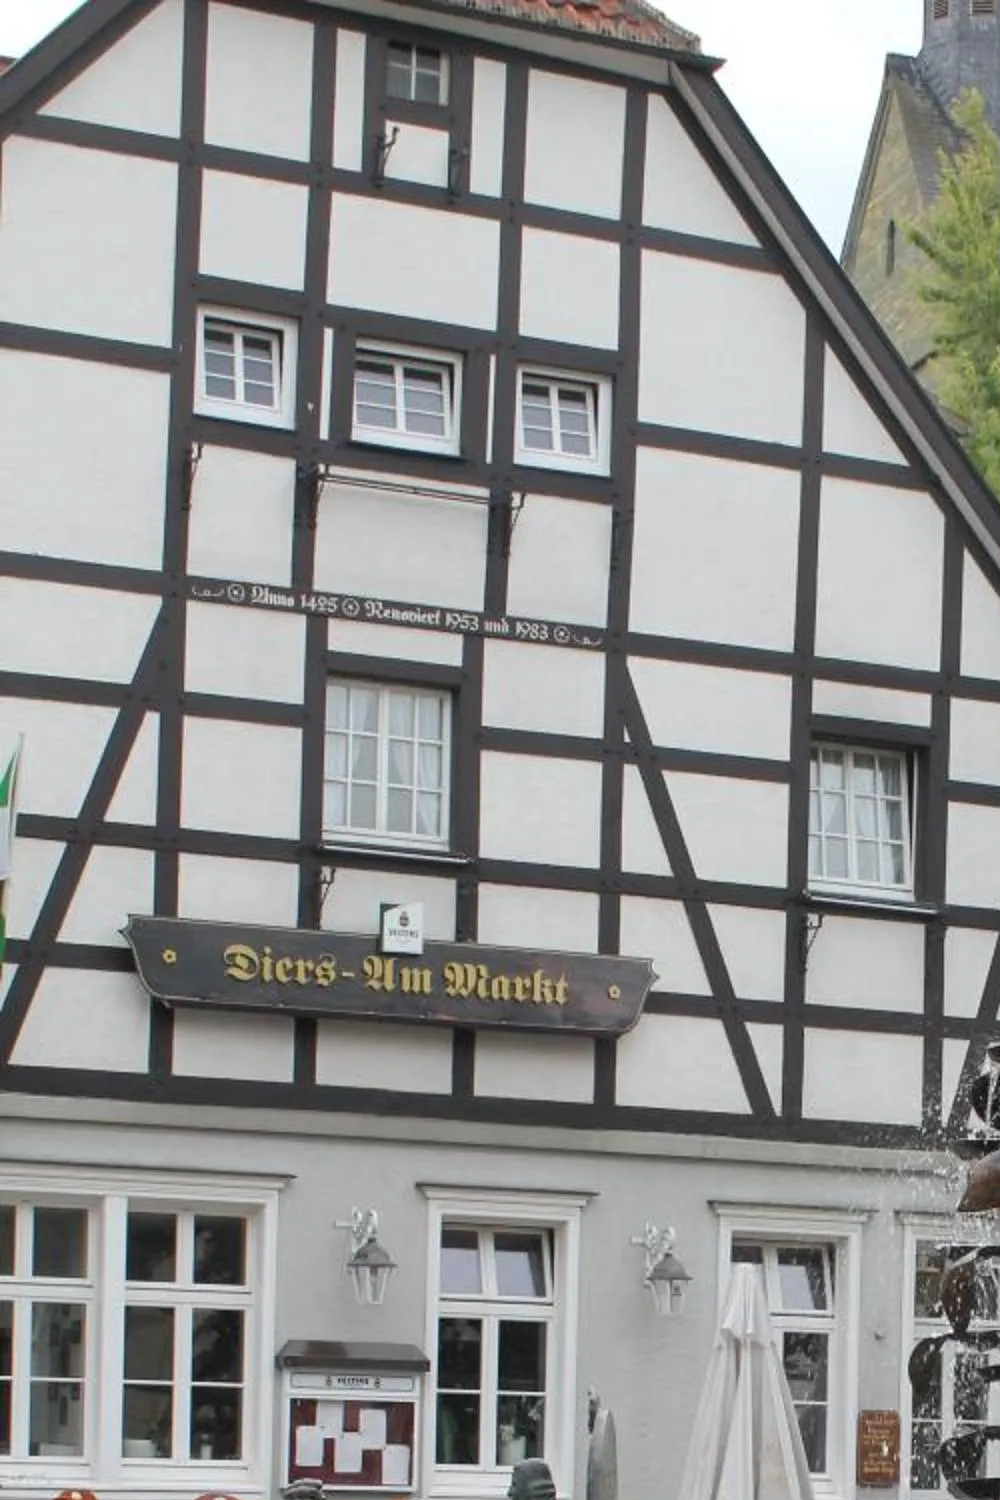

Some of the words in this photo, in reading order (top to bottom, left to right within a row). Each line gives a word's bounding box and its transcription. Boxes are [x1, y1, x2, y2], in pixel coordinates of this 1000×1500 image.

[251, 585, 295, 607] Anno
[301, 593, 338, 613] 1425
[364, 600, 441, 625] Renoviert
[445, 612, 480, 631] 1953
[484, 618, 509, 634] und
[515, 621, 549, 641] 1983
[362, 954, 433, 993] Am
[443, 961, 569, 1005] Markt
